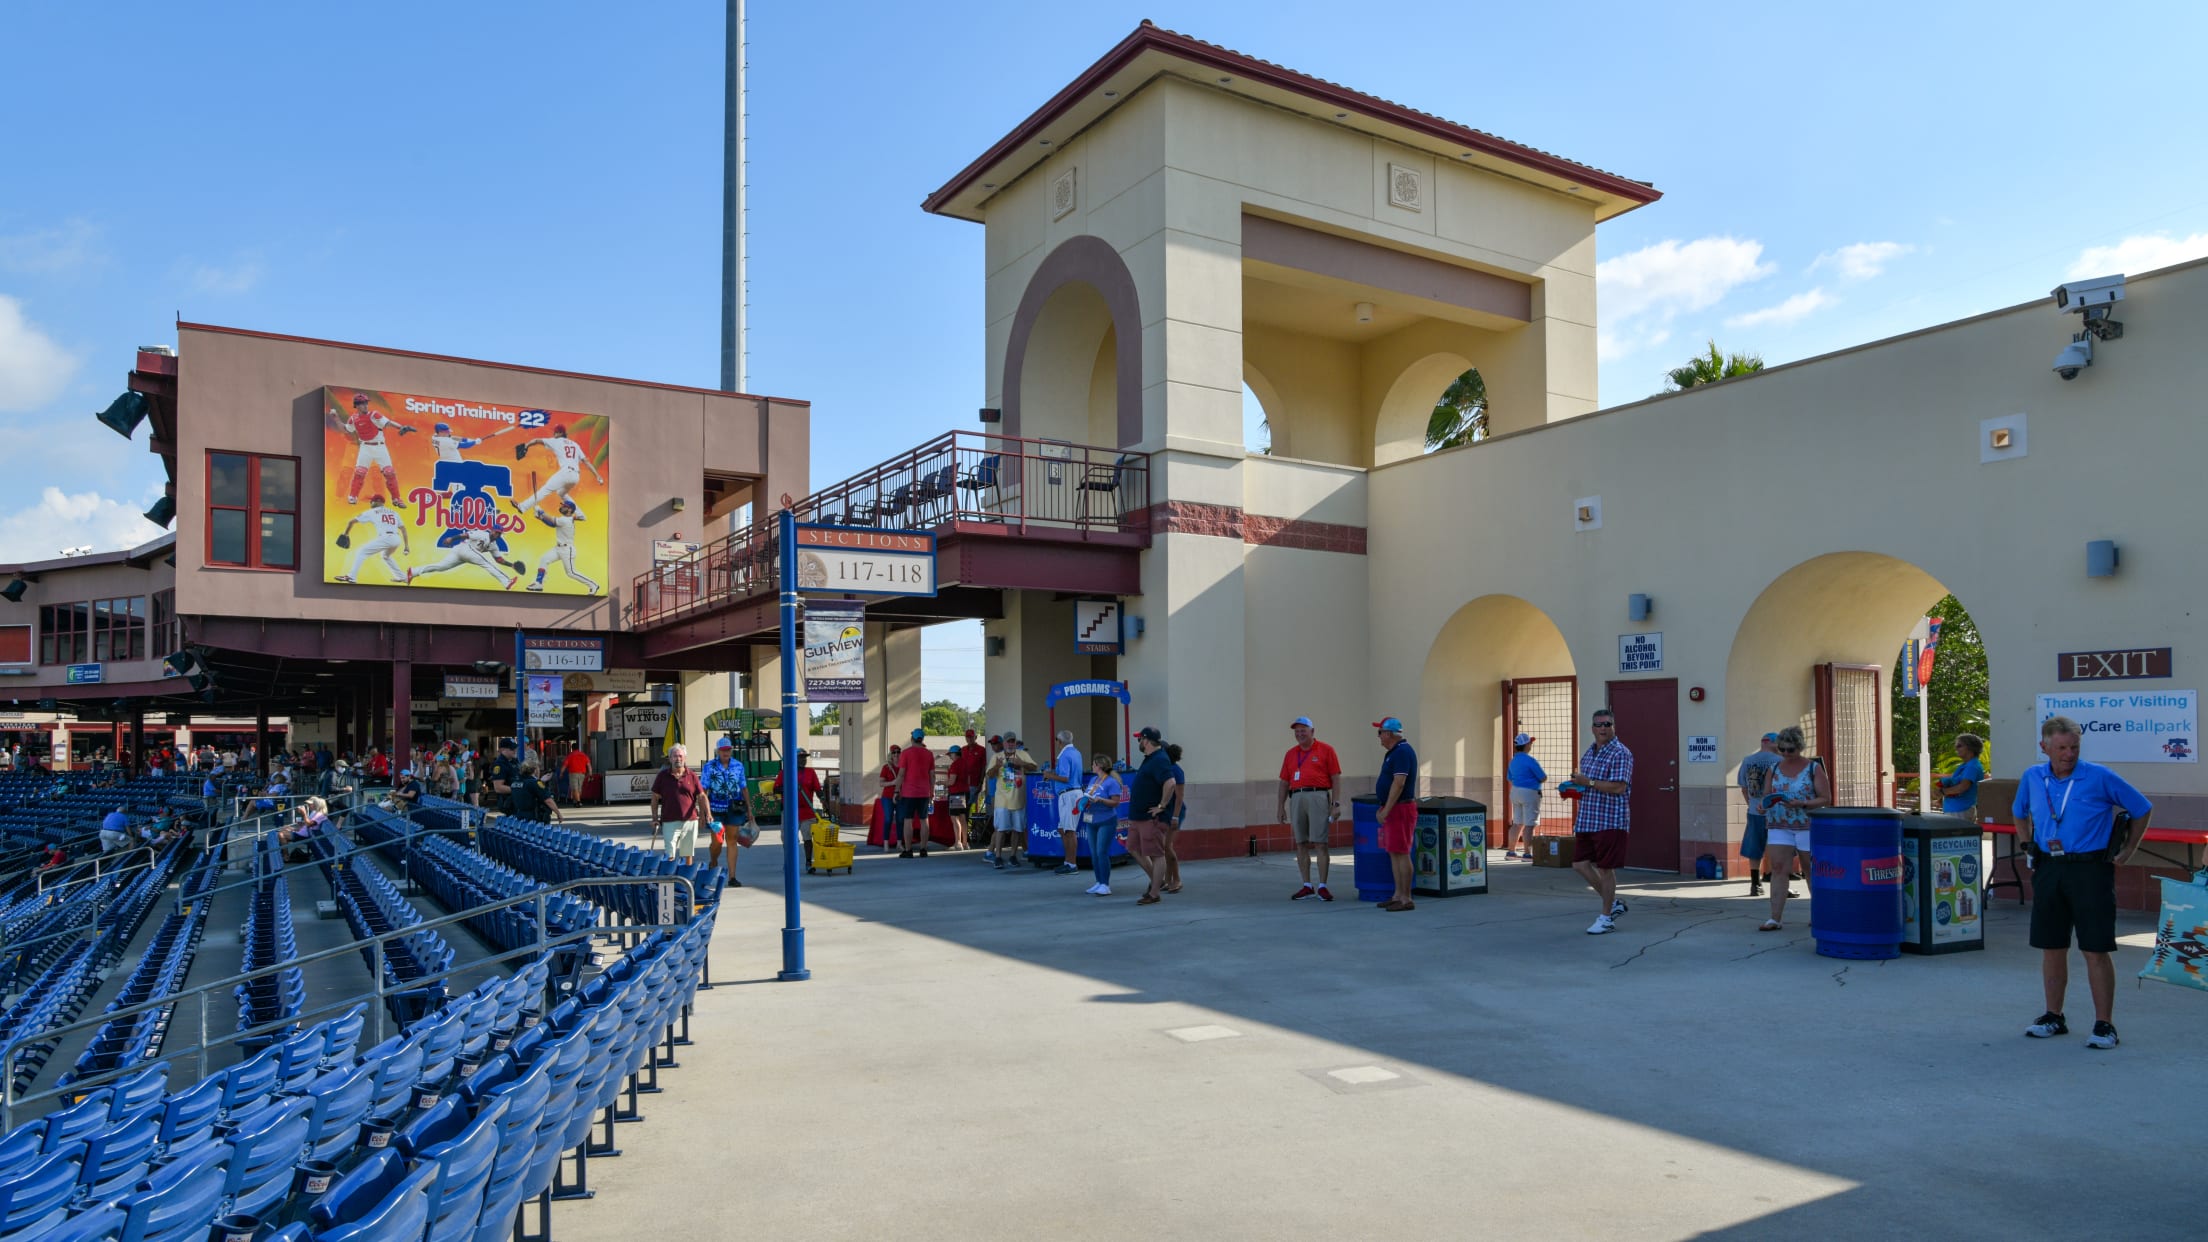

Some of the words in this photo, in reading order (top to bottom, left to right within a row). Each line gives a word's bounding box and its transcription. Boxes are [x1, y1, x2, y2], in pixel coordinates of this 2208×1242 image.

[520, 411, 545, 427] 22
[564, 446, 576, 459] 27
[408, 487, 526, 534] Phillies
[381, 514, 396, 526] 45
[809, 531, 921, 548] SECTIONS
[839, 560, 922, 584] 117-118
[531, 639, 596, 648] SECTIONS
[1635, 636, 1645, 644] NO
[1086, 644, 1111, 652] STAIRS
[1625, 644, 1656, 653] ALCOHOL
[548, 655, 595, 665] 116-117
[1626, 652, 1654, 661] BEYOND
[1621, 662, 1638, 670] THIS
[1640, 660, 1660, 669] POINT
[2072, 651, 2156, 678] EXIT
[1064, 684, 1110, 696] PROGRAMS
[2044, 698, 2095, 708] Thanks
[2100, 697, 2123, 707] For
[2129, 695, 2187, 708] Visiting
[626, 714, 666, 722] WINGS
[2080, 721, 2121, 734] yCare
[2125, 719, 2191, 734] Ballpark
[1692, 752, 1711, 761] Area
[1040, 829, 1061, 839] BayCa
[1933, 840, 1978, 849] RECYCLING
